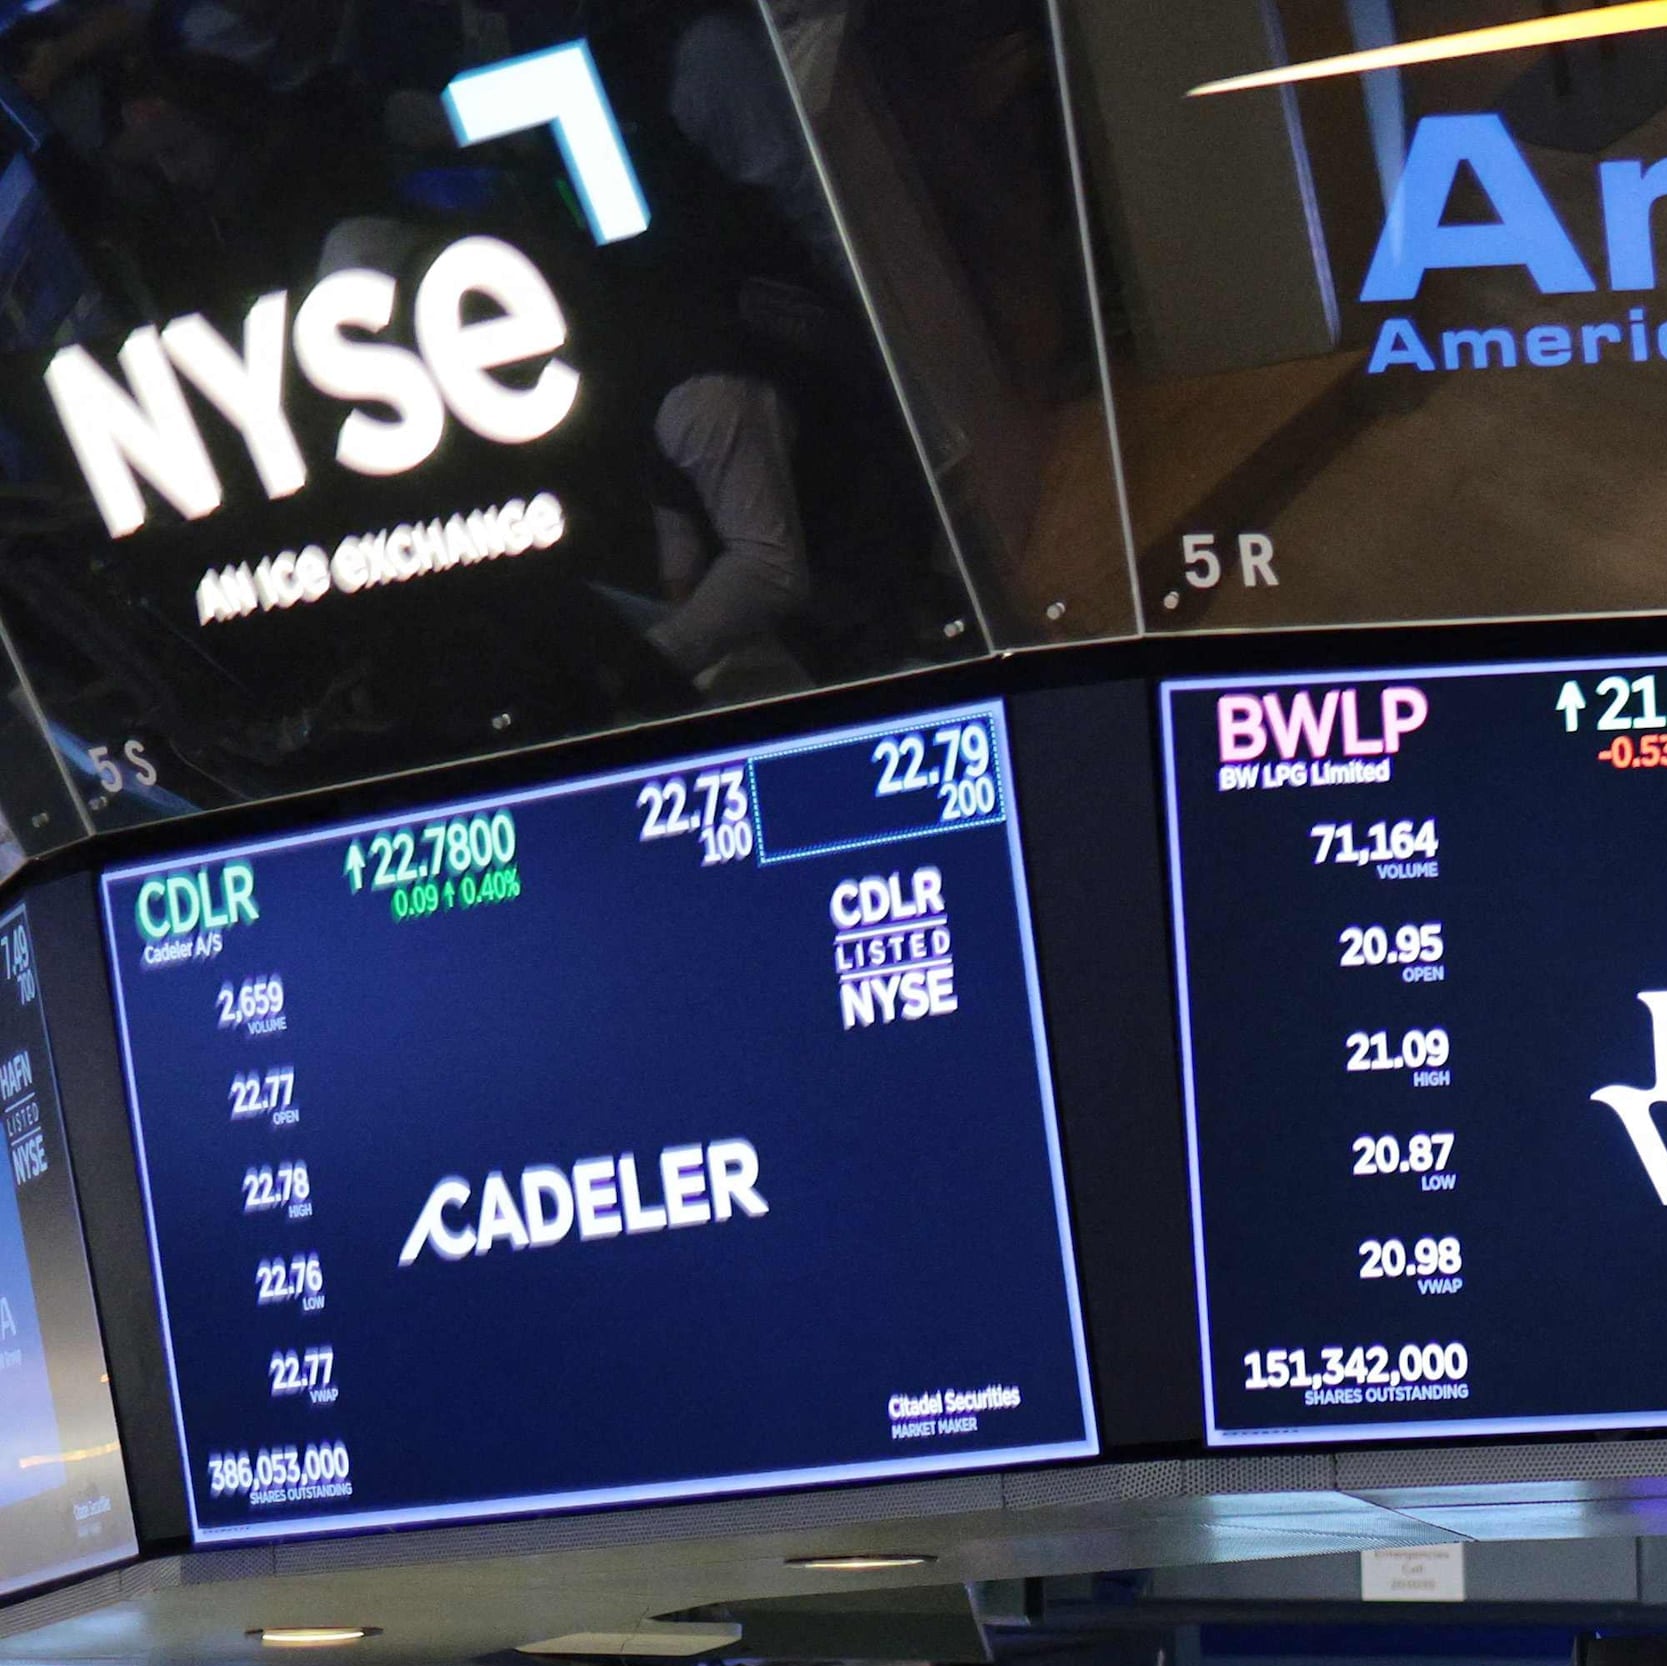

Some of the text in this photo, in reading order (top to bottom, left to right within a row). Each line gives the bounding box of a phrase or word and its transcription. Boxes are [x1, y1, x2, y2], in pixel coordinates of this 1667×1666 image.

[1216, 686, 1429, 762] BWLP
[871, 720, 990, 795] 22.79
[1219, 759, 1389, 791] BW LPG Limited
[636, 774, 749, 841] 22.73
[940, 777, 996, 822] 200
[369, 813, 516, 891] 22.7800
[700, 821, 752, 865] 100
[1311, 820, 1438, 866] 71,164
[1378, 863, 1438, 879] VOLUME
[136, 860, 260, 939] CDLR
[392, 867, 521, 919] 0.09 0.40%
[829, 869, 945, 928] CDLR
[1, 925, 29, 980] 7.49
[143, 939, 194, 965] Cadeler
[834, 928, 951, 970] LISTED
[1339, 924, 1443, 966] 20.95
[1403, 966, 1444, 983] OPEN
[215, 979, 285, 1033] 2,659
[838, 977, 958, 1030] NYSE
[1346, 1029, 1449, 1071] 21.09
[229, 1067, 296, 1117] 22.77
[1414, 1071, 1450, 1087] HIGH
[6, 1102, 40, 1138] LISTED
[272, 1108, 299, 1125] OPEN
[11, 1135, 48, 1186] NYSE
[1352, 1133, 1455, 1175] 20.87
[241, 1165, 311, 1213] 22.78
[401, 1138, 770, 1265] CADELER
[1422, 1175, 1455, 1191] LOW
[288, 1201, 312, 1218] HIGH
[1359, 1237, 1461, 1279] 20.98
[255, 1258, 324, 1304] 22.76
[302, 1294, 325, 1311] LOW
[1417, 1279, 1462, 1294] VWAP
[268, 1349, 334, 1397] 22.77
[1244, 1344, 1468, 1390] 151,342,000
[309, 1385, 339, 1403] VWAP
[887, 1383, 1021, 1420] Citadel Securities
[1305, 1383, 1468, 1406] SHARES OUTSTANDING
[891, 1416, 977, 1439] MARKET MAKER
[208, 1440, 350, 1498] 386,053,000
[288, 1479, 352, 1502] OUTSTANDING
